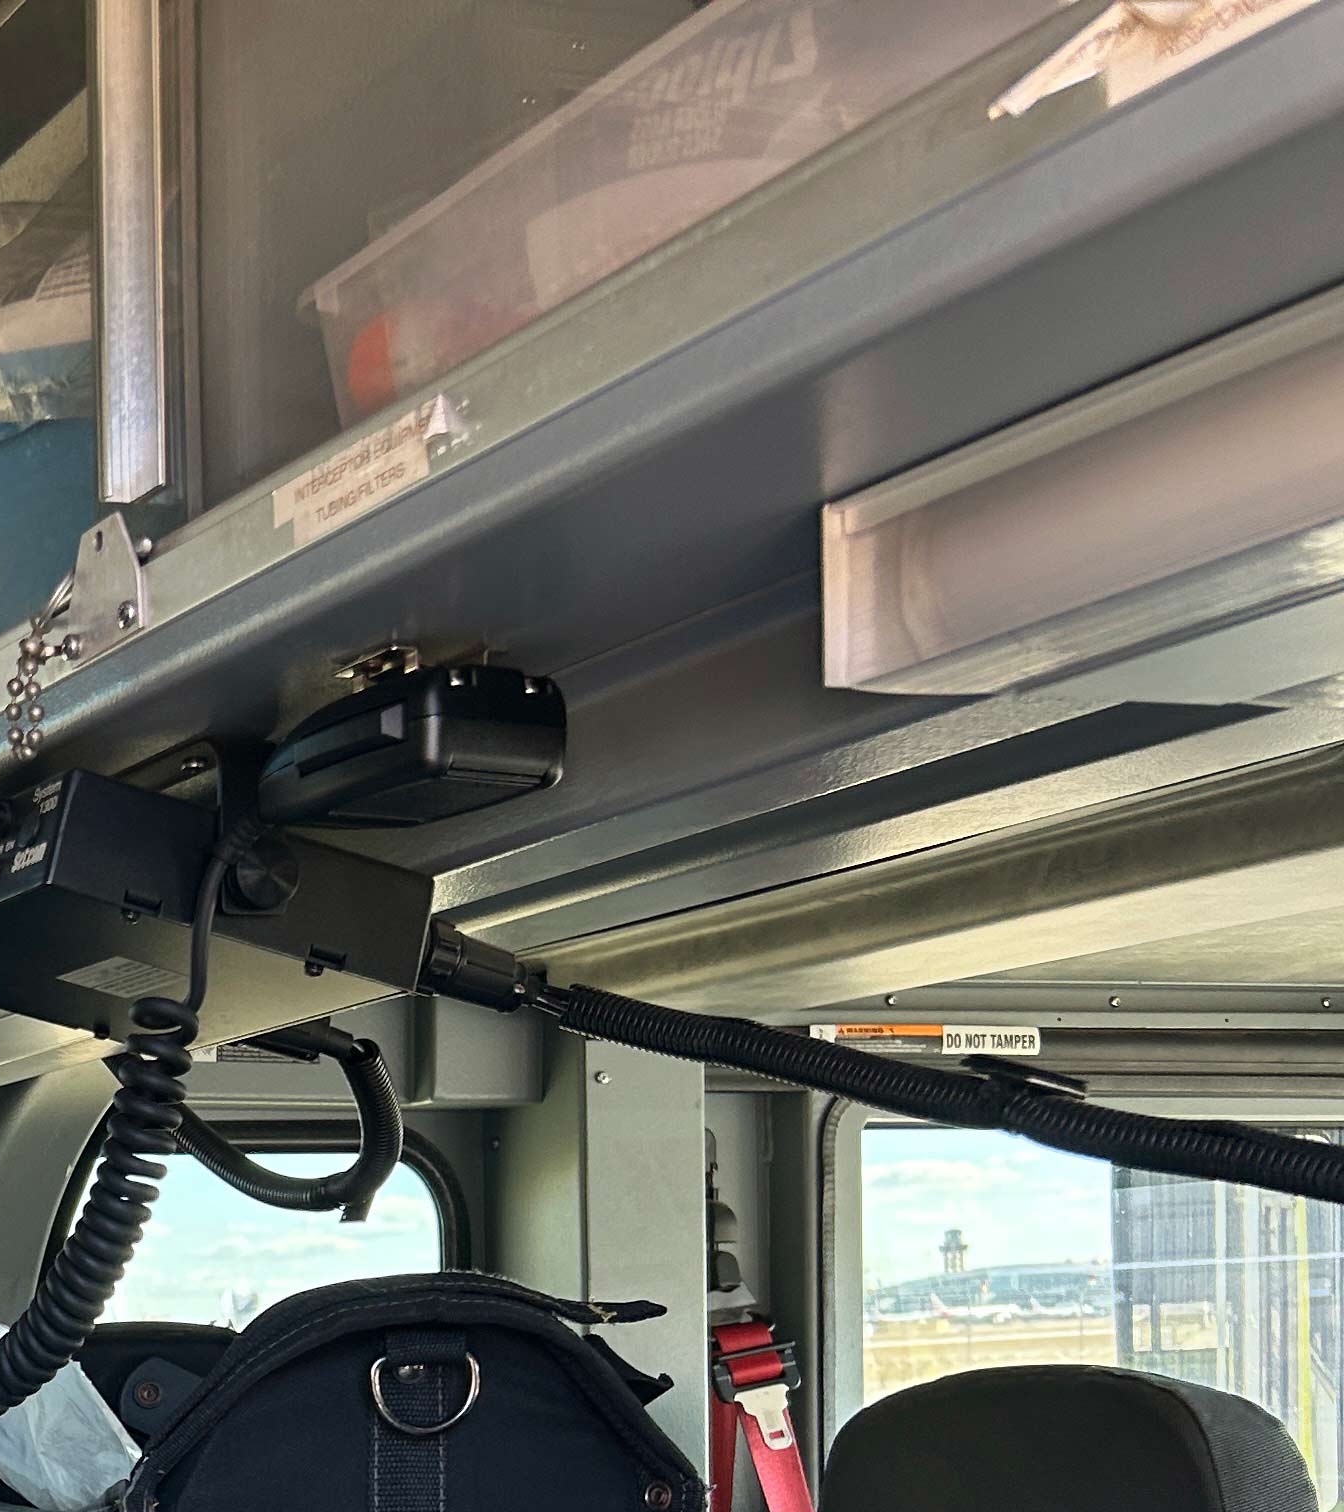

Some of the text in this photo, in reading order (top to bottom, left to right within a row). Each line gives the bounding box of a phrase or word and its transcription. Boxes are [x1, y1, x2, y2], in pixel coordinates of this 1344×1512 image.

[946, 1034, 963, 1049] DO
[965, 1034, 987, 1050] NOT
[989, 1034, 1036, 1050] TAMPER
